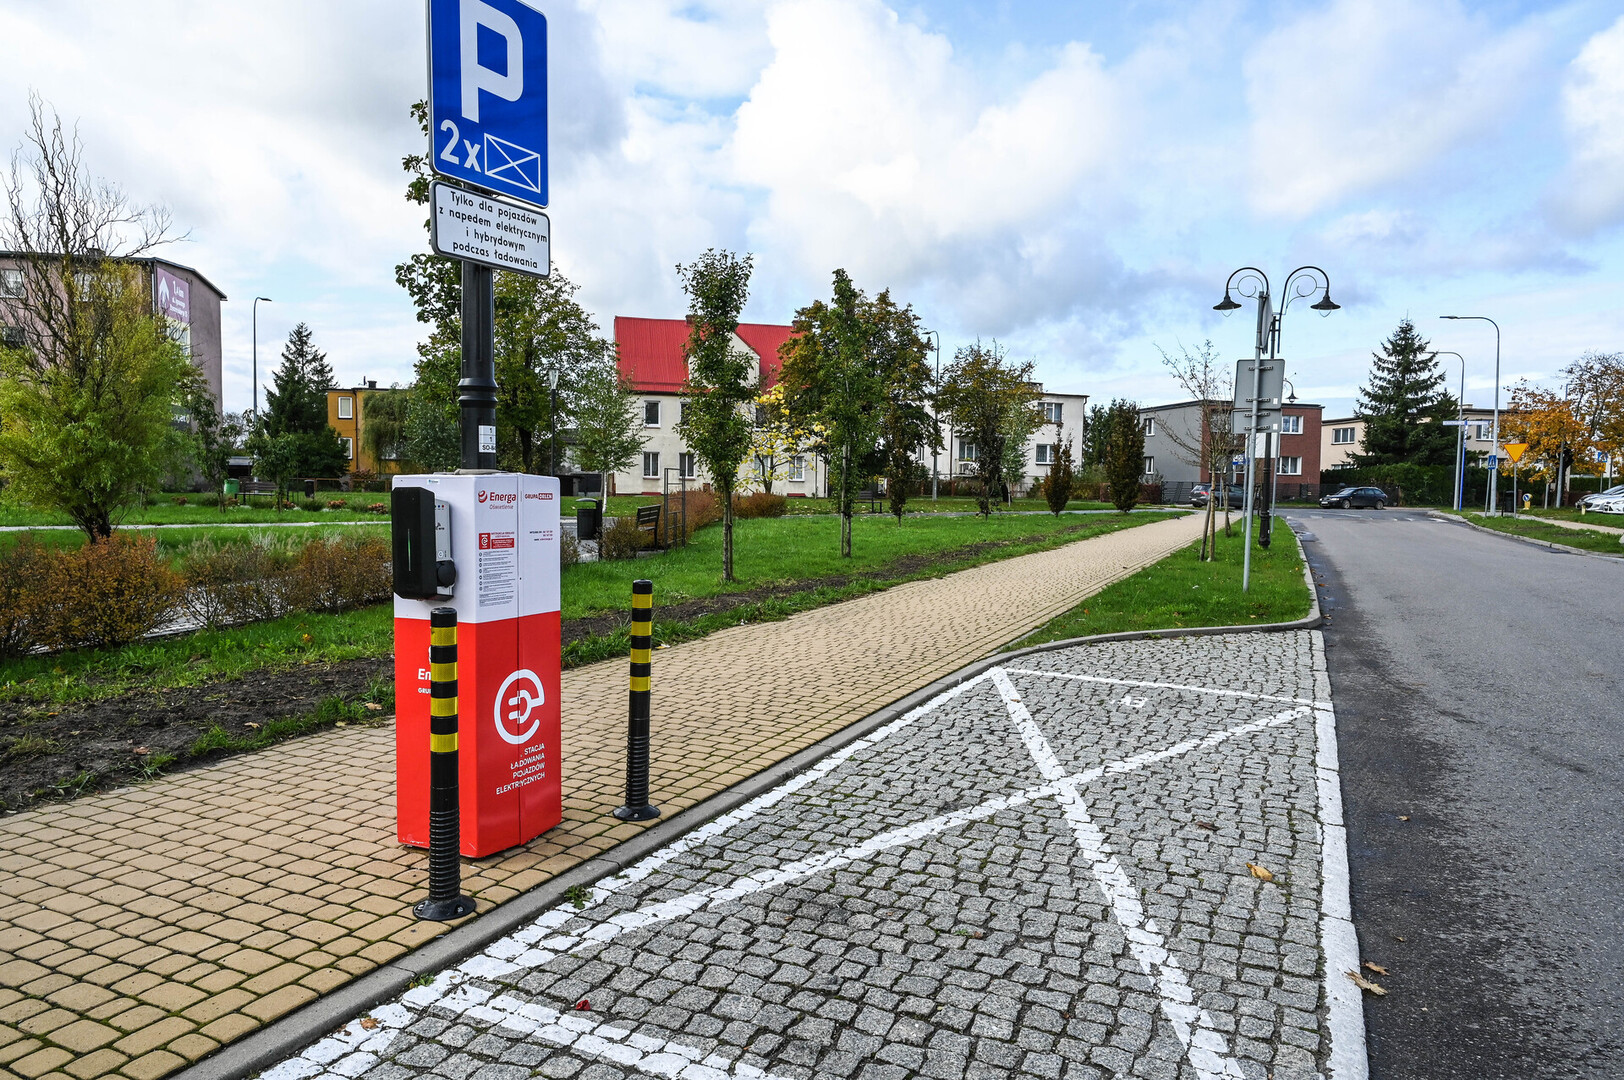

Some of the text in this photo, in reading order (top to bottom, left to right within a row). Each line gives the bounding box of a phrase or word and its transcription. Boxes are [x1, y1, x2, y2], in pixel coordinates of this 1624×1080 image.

[460, 0, 523, 123] P
[440, 119, 481, 173] 2x
[451, 191, 537, 225] Tylko dla pojazdów
[466, 227, 525, 252] i hybrydowym
[496, 221, 547, 243] elektrycznym
[453, 242, 538, 268] podczas ładowania
[489, 492, 517, 504] Energa
[510, 752, 545, 769] ŁADOWANIA
[524, 743, 545, 755] STACJA
[512, 762, 545, 779] POJAZDÓW
[496, 772, 545, 795] ELEKTRYCZNYCH
